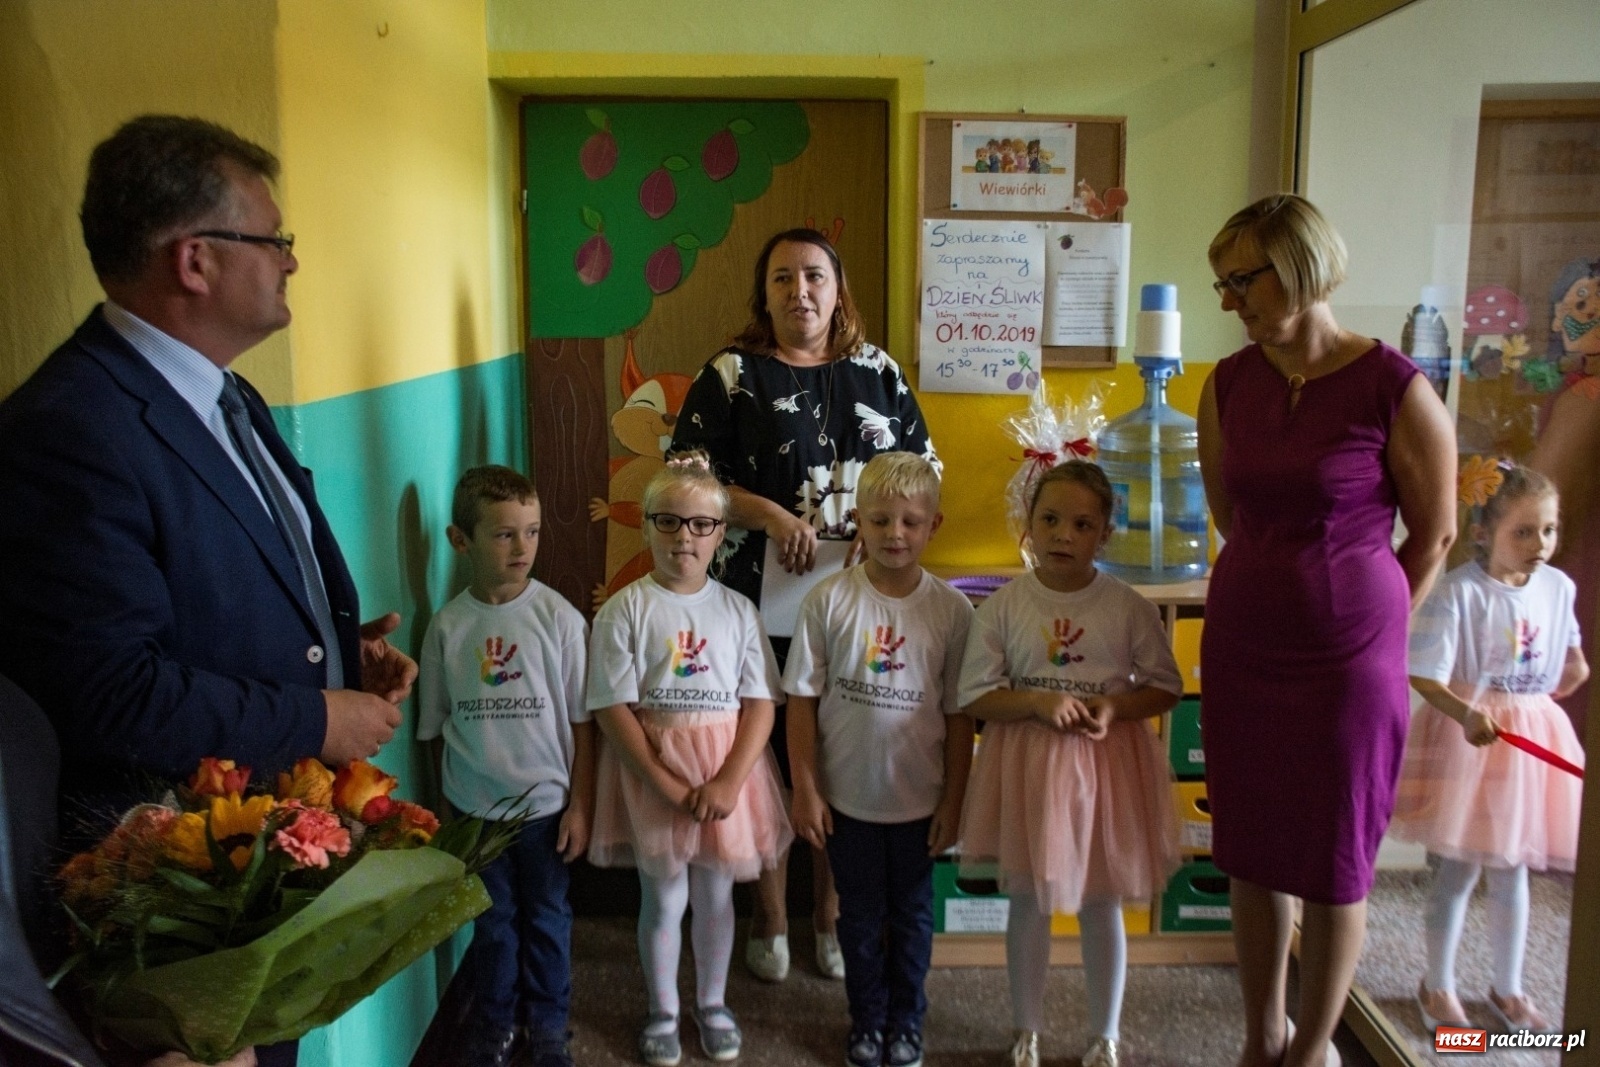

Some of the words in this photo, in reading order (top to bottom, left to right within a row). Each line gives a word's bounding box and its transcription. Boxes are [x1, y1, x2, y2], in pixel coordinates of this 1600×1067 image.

[979, 182, 1046, 196] Wiewiórki
[930, 222, 1029, 247] Serdecznie
[937, 254, 1030, 277] zapraszamy
[967, 271, 988, 279] na
[926, 283, 986, 307] DZIEŃ
[936, 322, 1036, 343] 01.10.2019
[835, 676, 925, 703] PRZEDSZKOLE
